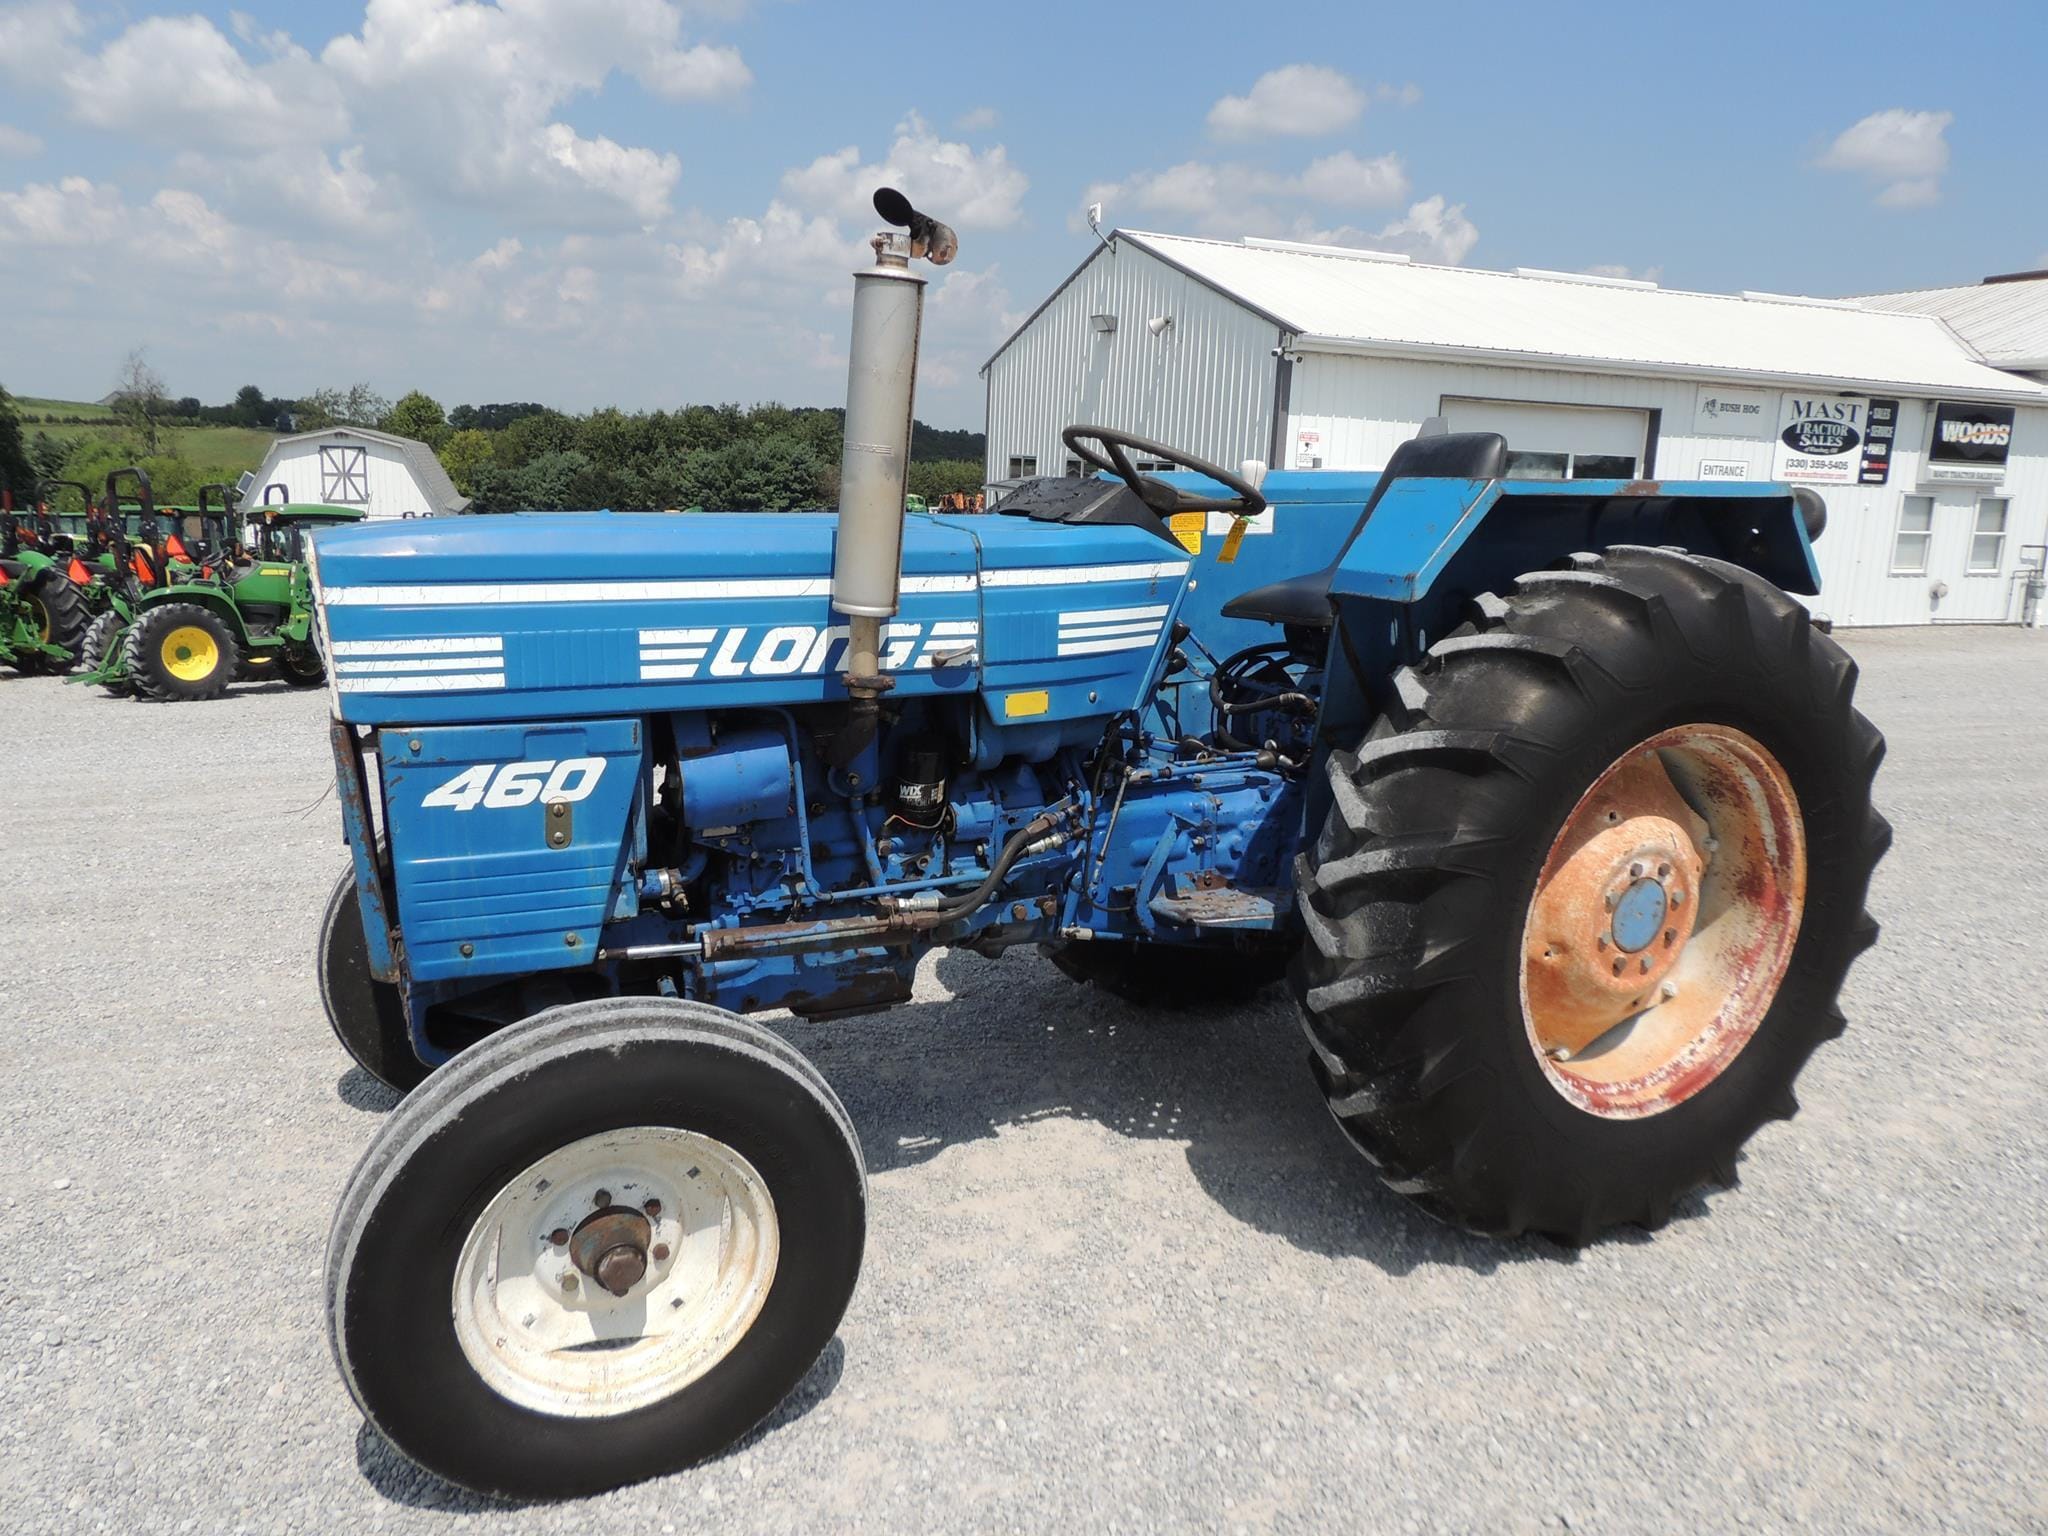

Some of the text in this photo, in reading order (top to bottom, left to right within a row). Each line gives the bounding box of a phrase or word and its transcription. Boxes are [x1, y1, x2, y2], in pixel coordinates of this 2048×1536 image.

[1719, 403, 1760, 414] BUSH HOG
[1791, 399, 1862, 423] MAST
[1795, 422, 1849, 437] TRACTOR
[1942, 420, 2010, 446] WOODS
[1799, 433, 1844, 448] SALES
[1703, 464, 1745, 477] ENTRANCE
[1786, 458, 1808, 470] (330)
[709, 622, 922, 677] LONG
[420, 757, 607, 811] 460
[900, 784, 922, 796] WIX
